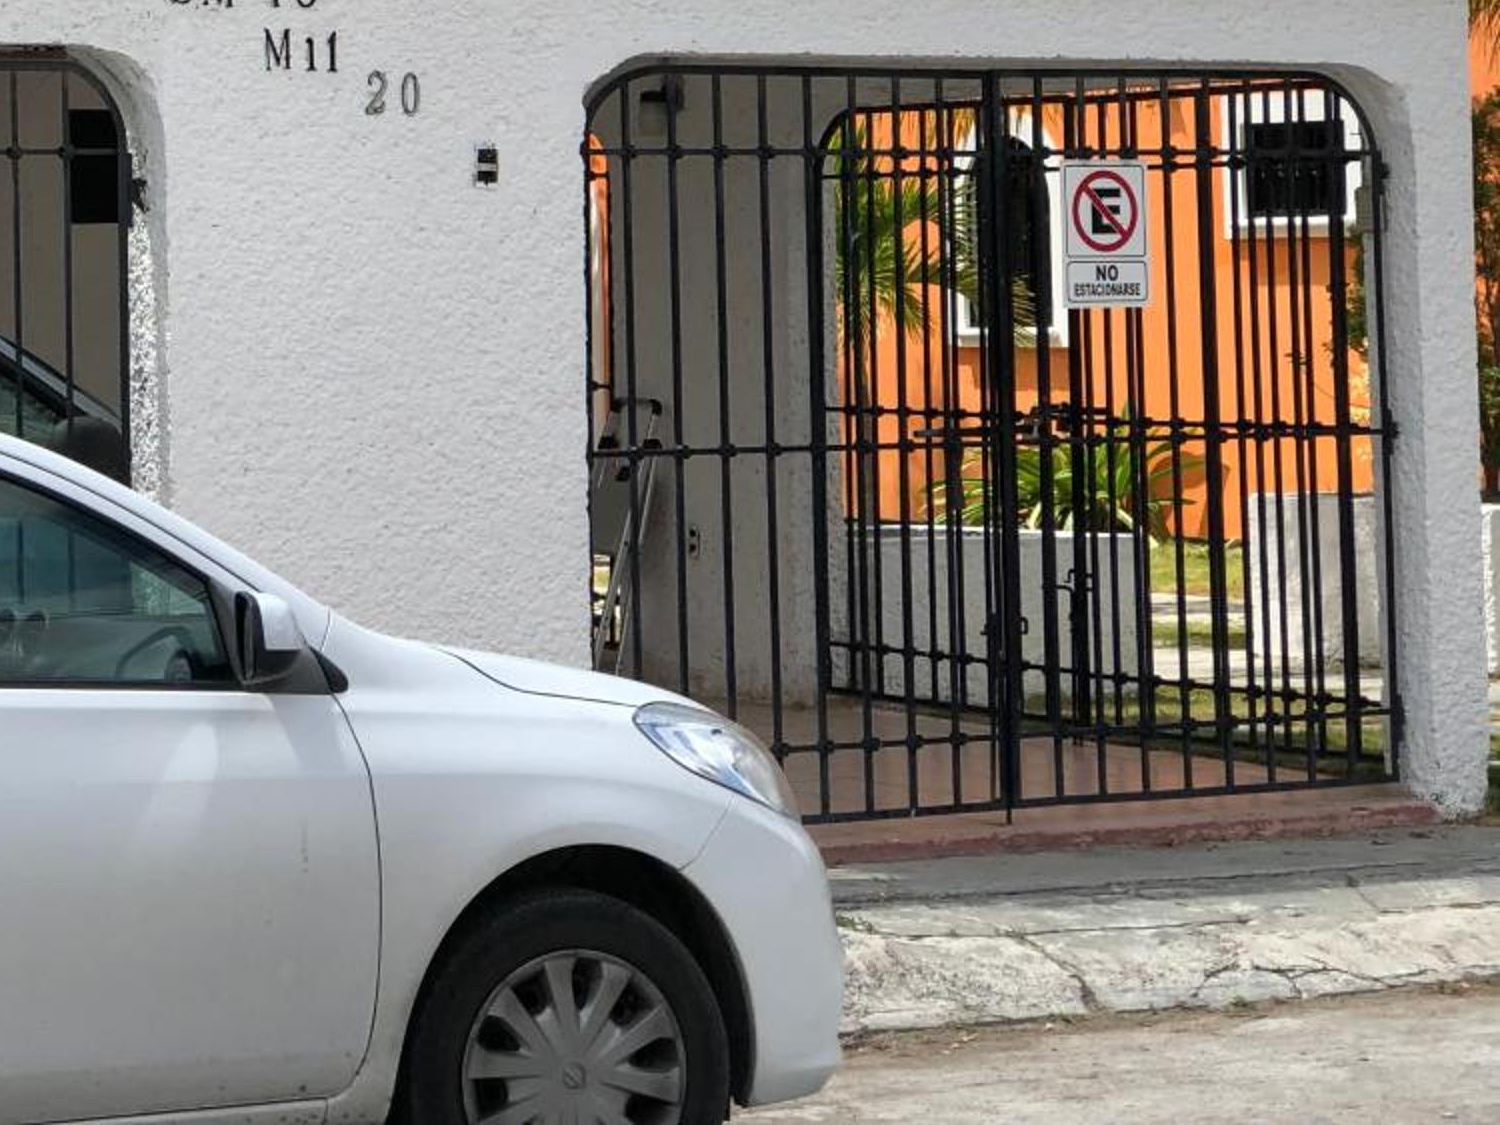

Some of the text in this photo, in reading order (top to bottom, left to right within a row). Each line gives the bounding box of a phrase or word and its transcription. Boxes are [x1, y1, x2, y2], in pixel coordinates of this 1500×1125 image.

[365, 70, 422, 116] 20
[1095, 264, 1119, 282] NO
[1073, 282, 1141, 297] ESTACIONARSE
